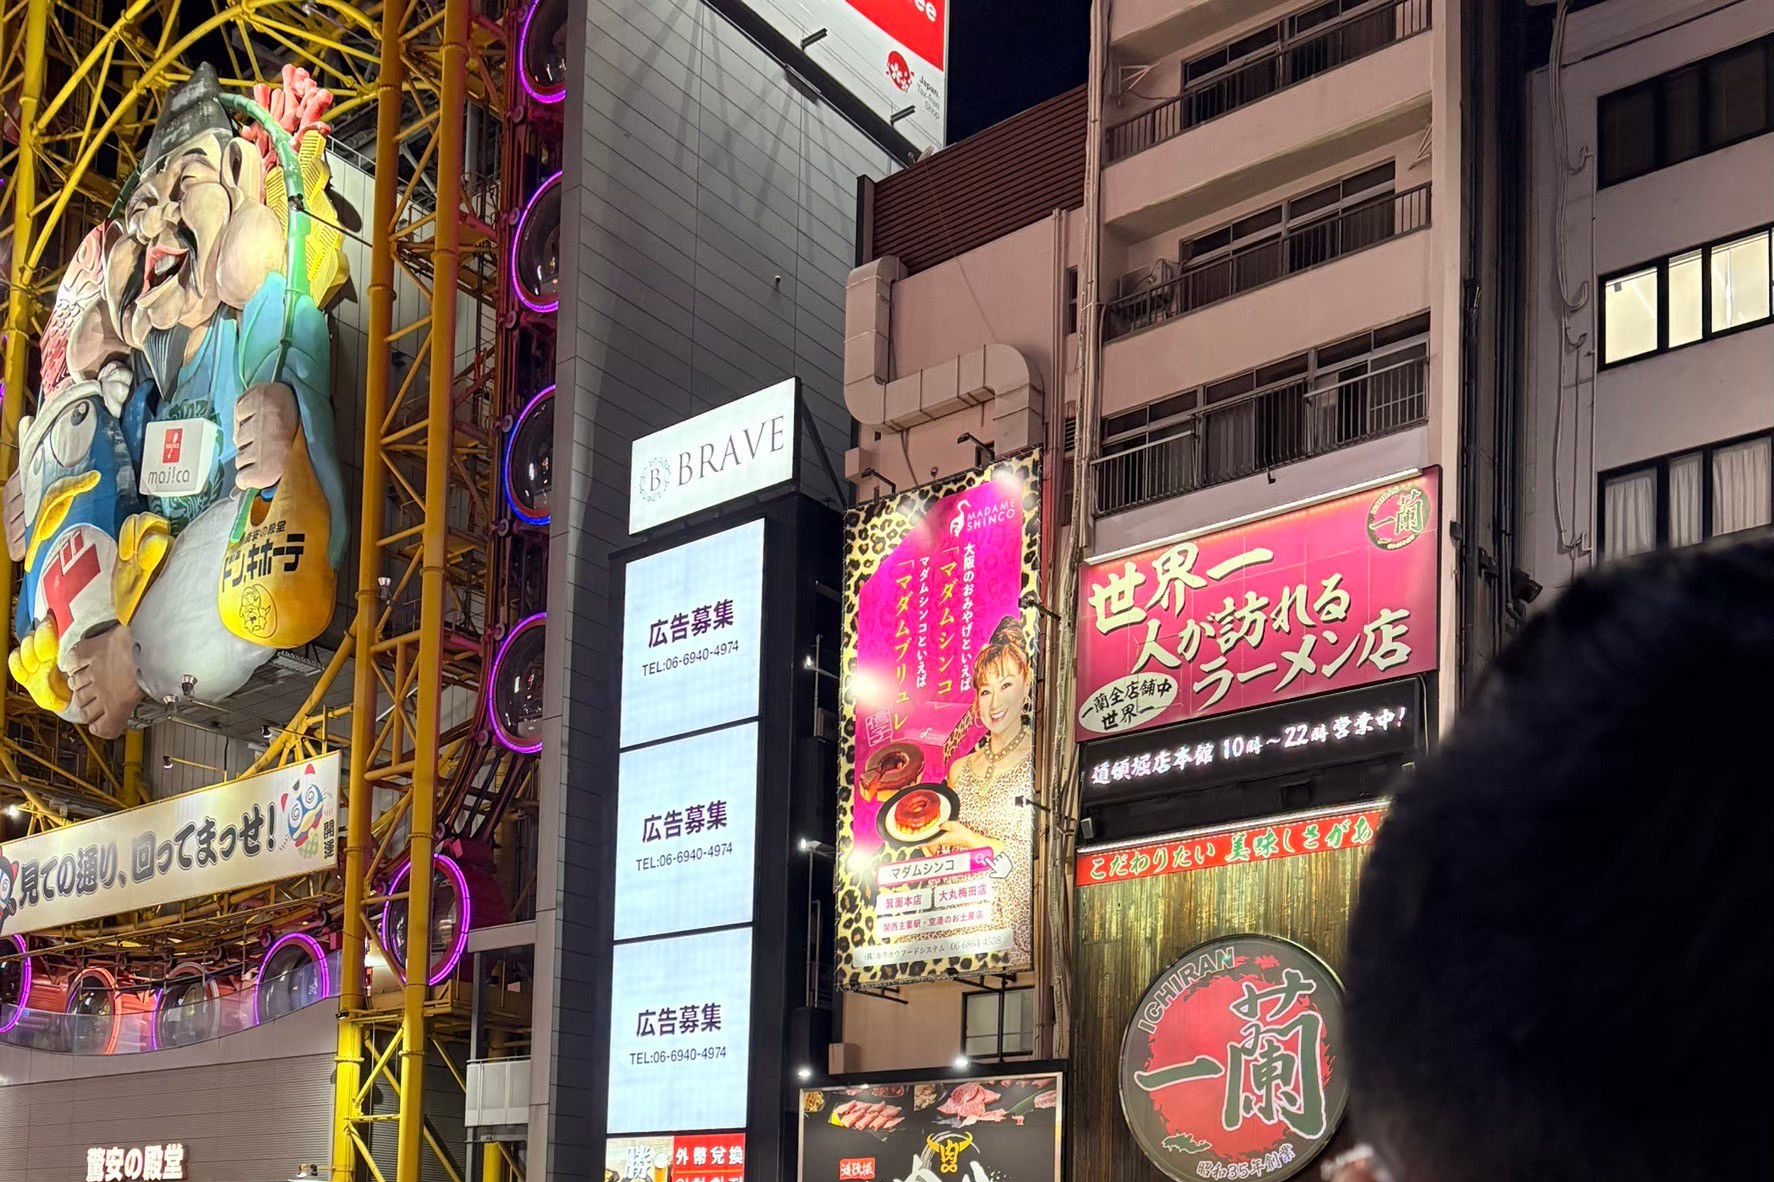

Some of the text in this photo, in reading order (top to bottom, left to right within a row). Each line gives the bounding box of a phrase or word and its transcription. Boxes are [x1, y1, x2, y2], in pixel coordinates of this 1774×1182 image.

[677, 415, 785, 487] BRAVE
[966, 499, 1016, 520] MADAME
[966, 508, 1016, 532] SHINCO
[1369, 489, 1424, 535] 一蘭
[1088, 542, 1274, 635] 世界一
[648, 598, 734, 648] 広告募集
[916, 555, 931, 689] マダムシンコといえば
[959, 542, 977, 692] 大阪のおみやげといえば
[1131, 573, 1351, 674] 人が訪れる
[642, 640, 739, 676] TEL:06-6940-4974
[1193, 608, 1412, 711] ラーメン店
[1081, 674, 1173, 719] 一蘭全店舗中
[1101, 703, 1154, 731] 世界一
[1092, 744, 1214, 786] 道頓堀店本館
[642, 799, 728, 843] 広告募集
[636, 842, 733, 871] TEL:06-6940-4974
[891, 858, 955, 880] マダムシンコ
[1089, 815, 1385, 880] こだわりたい 美味しさがあ
[939, 884, 987, 903] 大丸梅田店
[1138, 946, 1236, 1035] ICHIRAN
[636, 1002, 722, 1038] 広告募集
[629, 1046, 727, 1065] TEL:06-6940-4974
[1133, 967, 1327, 1140] 一蘭
[86, 1143, 184, 1182] 驚安の殿堂
[675, 1146, 744, 1166] 外幣兌換
[1196, 1143, 1296, 1181] 昭和35年創業
